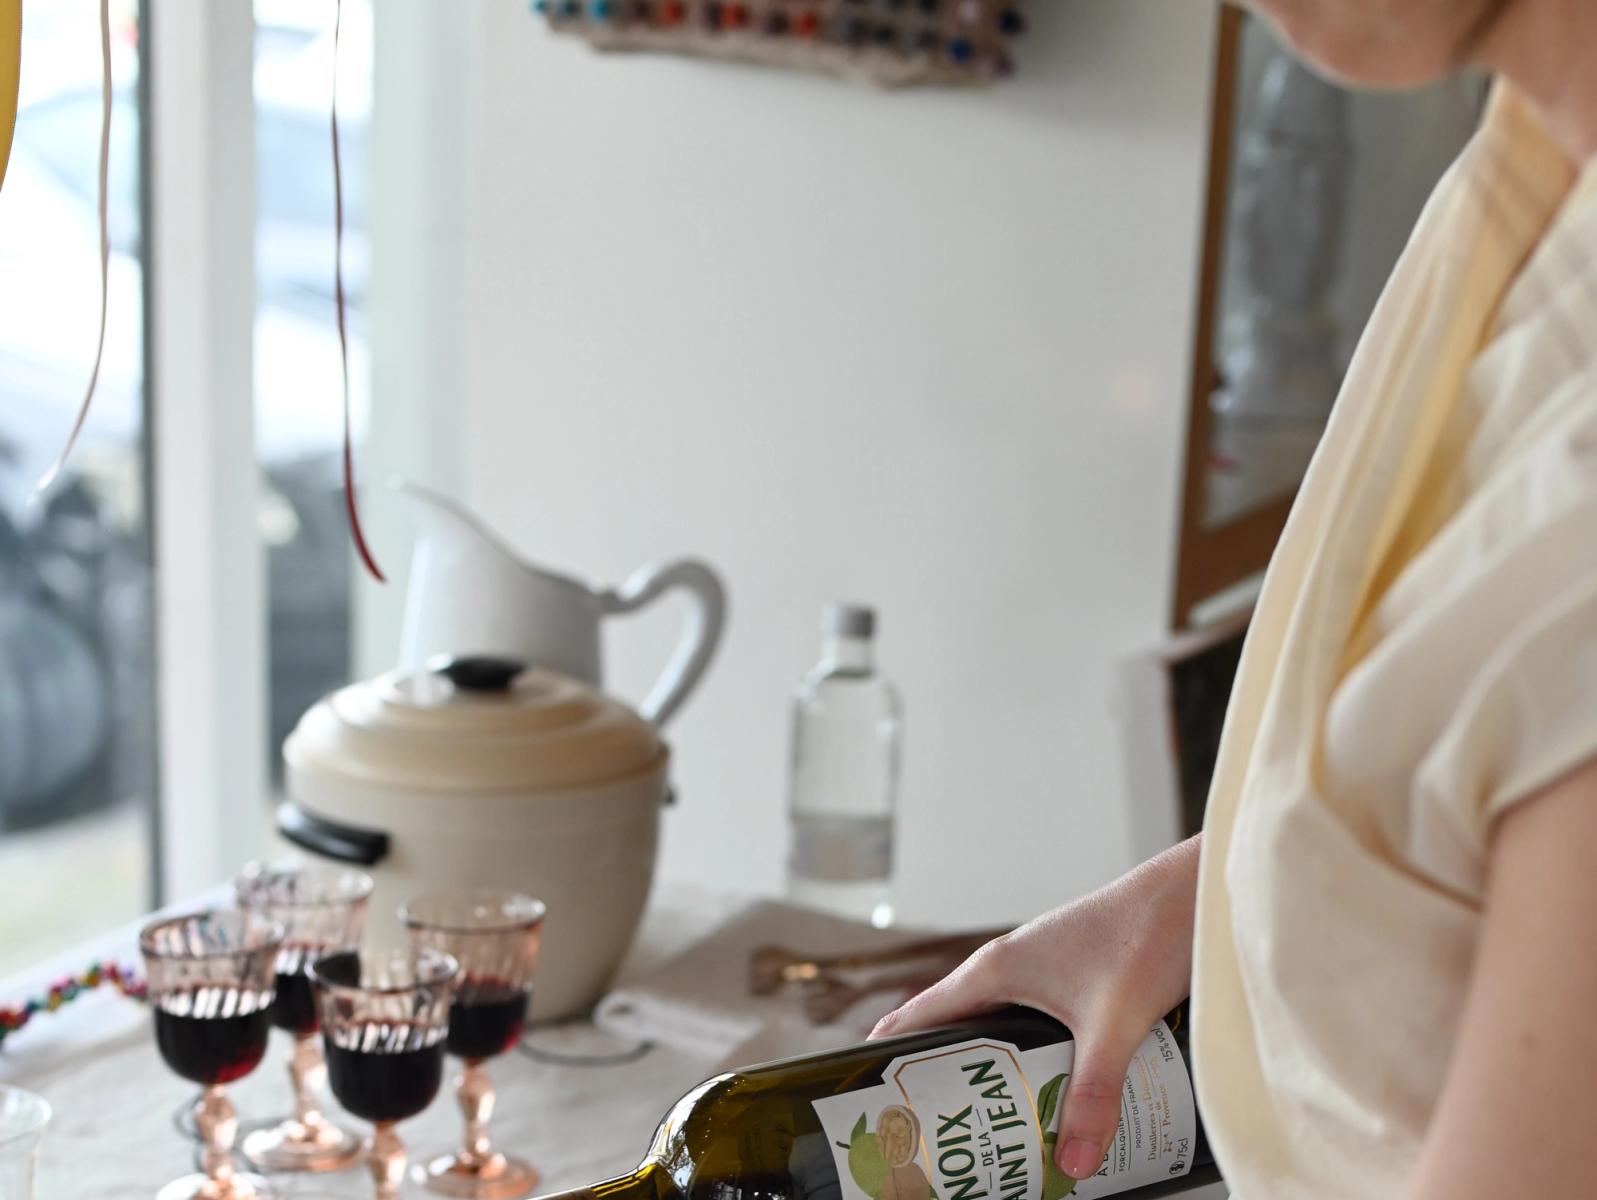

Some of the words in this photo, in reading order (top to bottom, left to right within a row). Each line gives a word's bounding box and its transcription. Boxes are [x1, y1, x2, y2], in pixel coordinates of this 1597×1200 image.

[960, 1058, 1028, 1133] JEAN
[1131, 1105, 1140, 1115] DE
[978, 1131, 992, 1148] LA
[1134, 1117, 1142, 1149] PRODUIT
[980, 1150, 995, 1167] DE
[1176, 1137, 1189, 1160] 75cl
